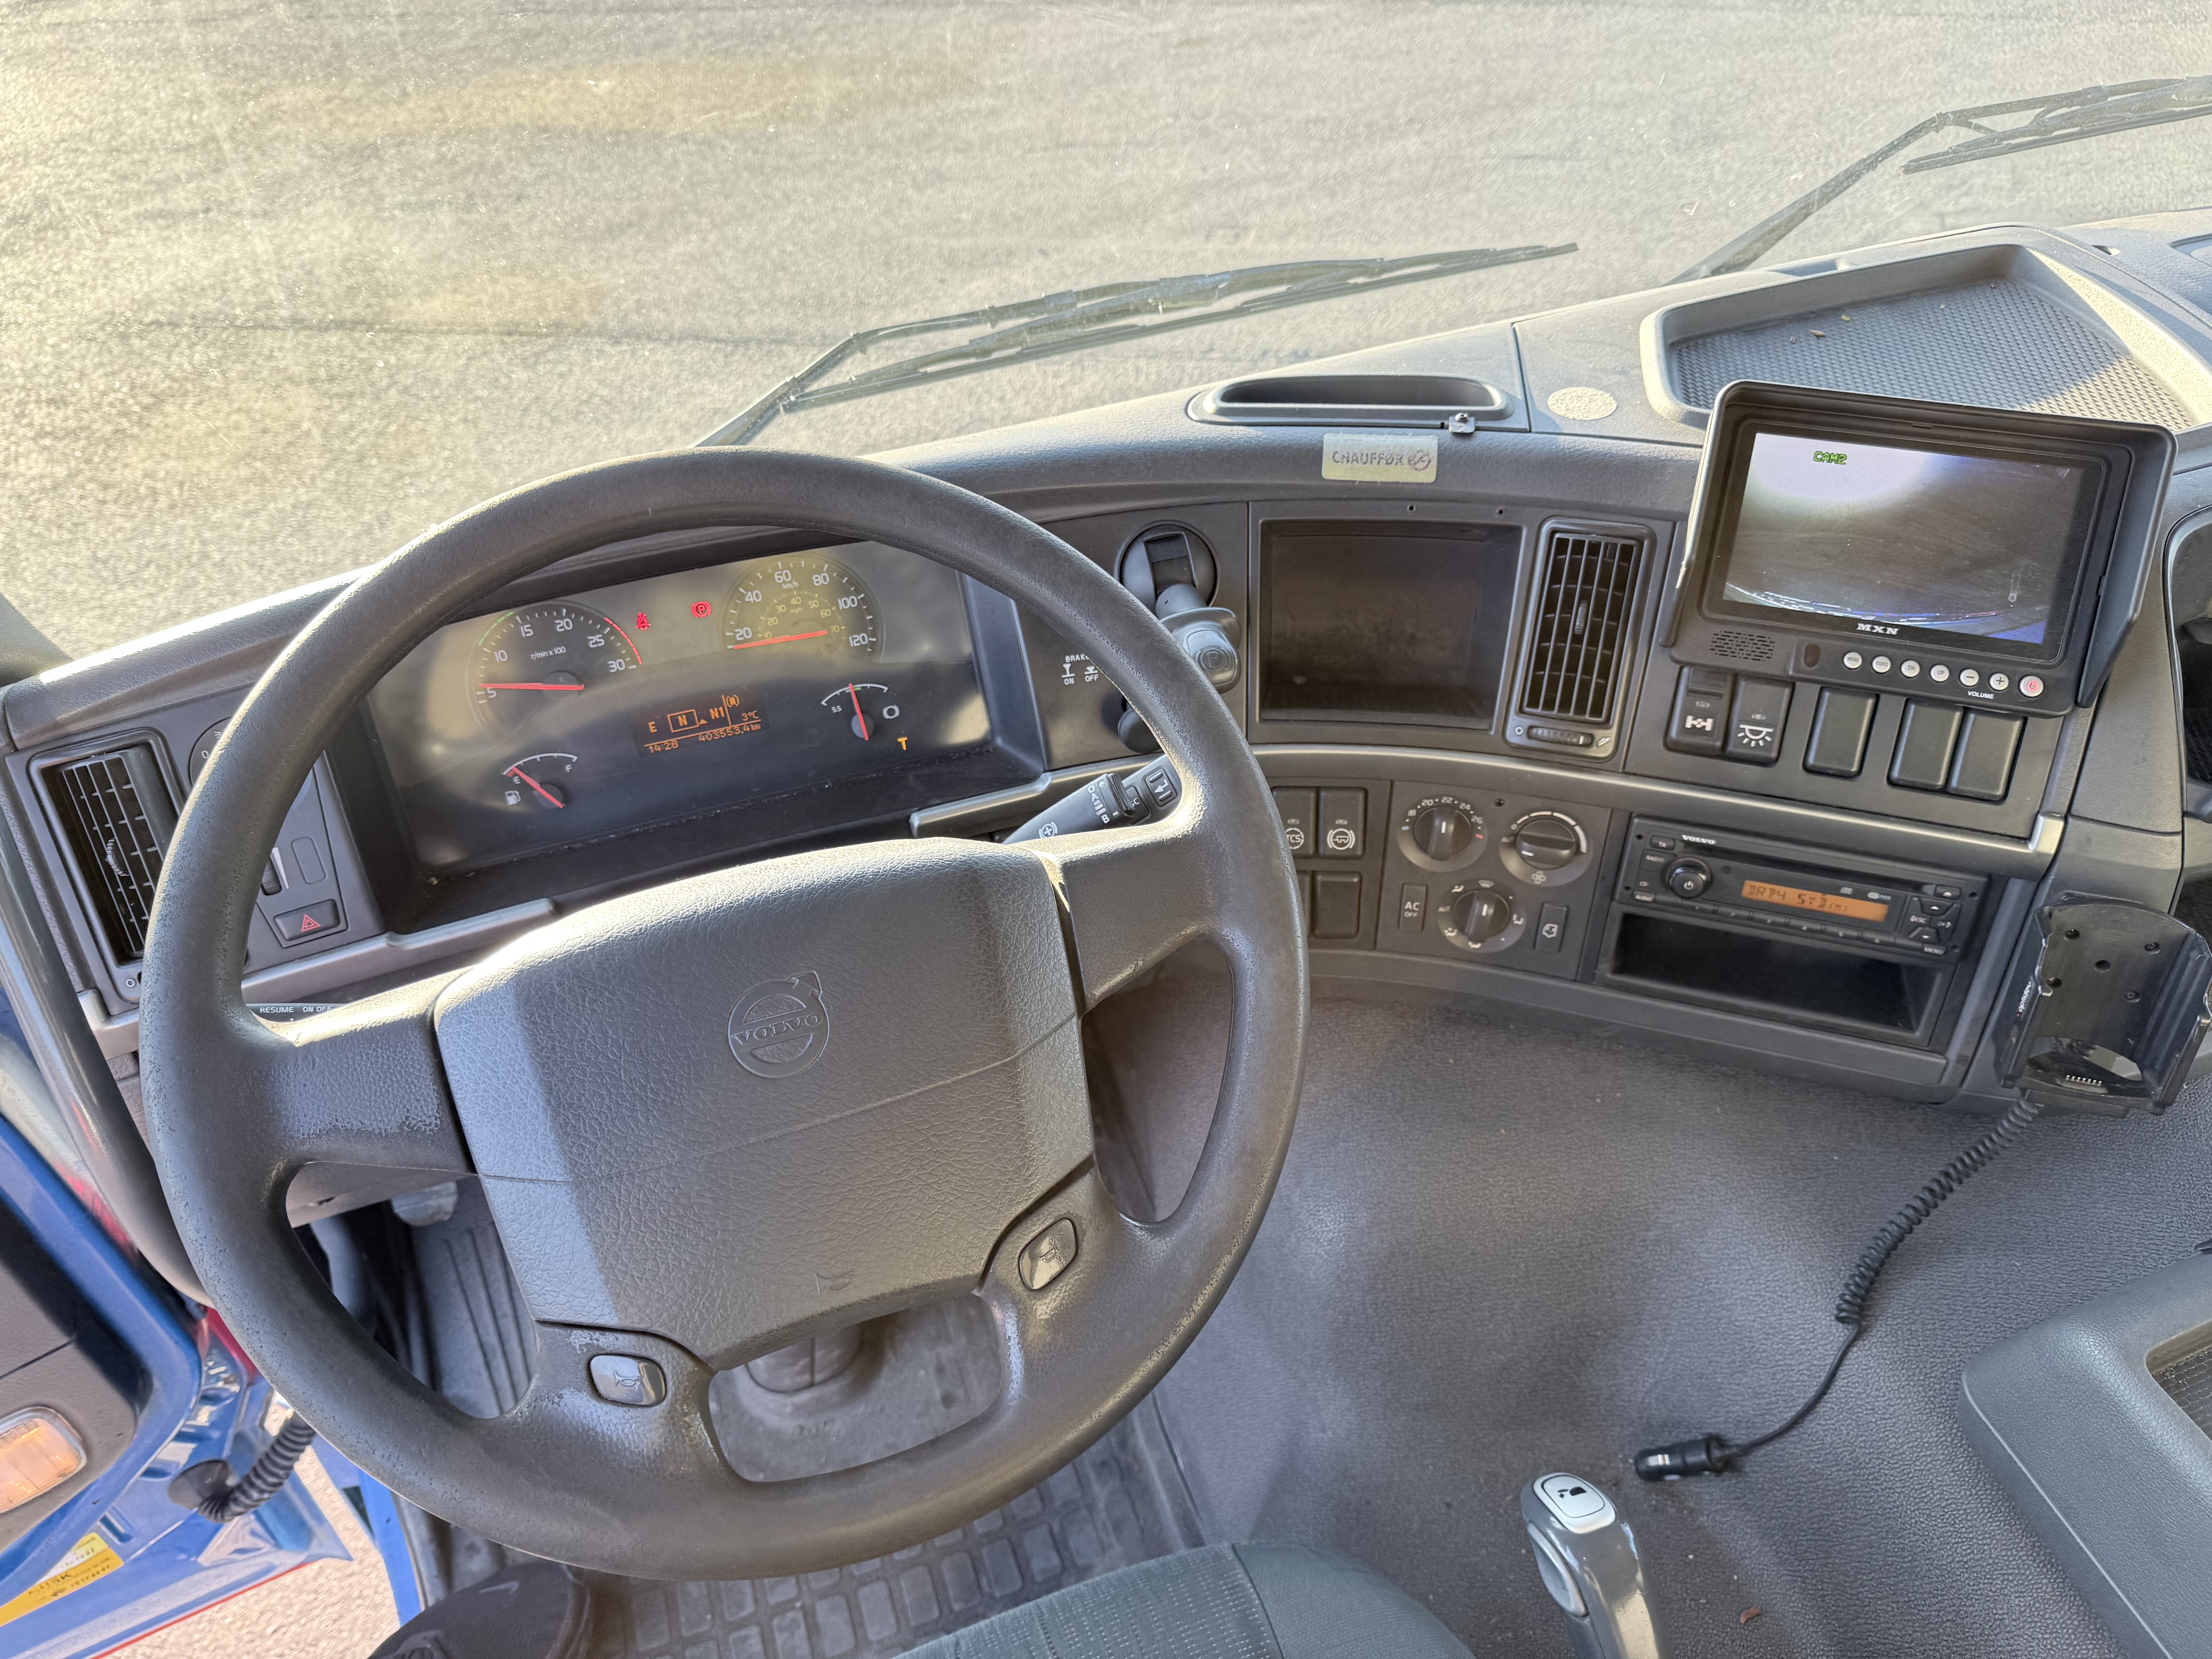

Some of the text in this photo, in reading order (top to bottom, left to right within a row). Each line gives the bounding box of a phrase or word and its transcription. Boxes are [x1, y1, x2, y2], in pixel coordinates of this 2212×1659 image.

[1813, 451, 1847, 465] CAM2
[775, 570, 792, 583] 60
[813, 573, 830, 586] 80
[782, 580, 799, 589] km/h
[745, 590, 762, 603] 40
[791, 596, 802, 605] 40
[809, 600, 819, 608] 50
[838, 596, 858, 610] 100
[776, 605, 787, 613] 30
[821, 609, 831, 618] 60
[555, 618, 573, 632] 20
[768, 617, 778, 626] 20
[520, 624, 534, 637] 15
[735, 627, 752, 641] 20
[830, 625, 840, 634] 70
[1856, 623, 1899, 635] MXN
[588, 634, 605, 648] 25
[849, 634, 868, 647] 120
[495, 650, 508, 663] 10
[531, 651, 548, 661] r/min
[554, 646, 566, 655] 100
[608, 659, 625, 673] 30
[1085, 674, 1099, 682] OFF
[487, 687, 497, 698] 5
[1968, 690, 1994, 699] VOLUME
[709, 706, 725, 720] N1
[678, 715, 688, 726] N
[648, 722, 658, 733] E
[649, 740, 679, 753] 14:28
[897, 737, 908, 750] T
[565, 764, 572, 772] F
[513, 776, 521, 784] E
[1459, 802, 1471, 811] 24
[1101, 814, 1110, 824] B
[1471, 815, 1483, 824] 26
[1681, 834, 1717, 845] VOLVO
[1405, 901, 1420, 911] AC
[731, 1013, 823, 1046] VOLVO
